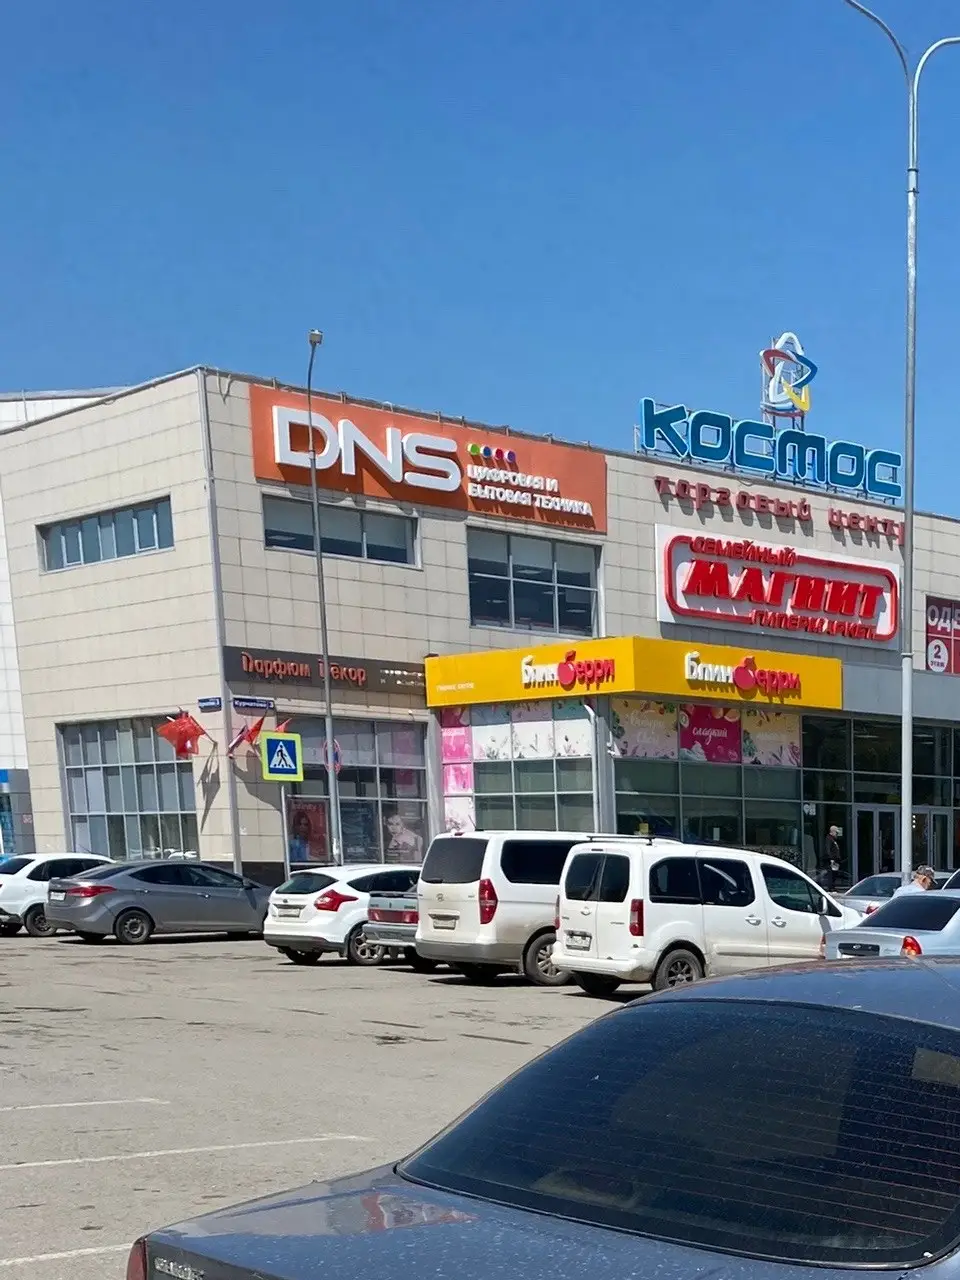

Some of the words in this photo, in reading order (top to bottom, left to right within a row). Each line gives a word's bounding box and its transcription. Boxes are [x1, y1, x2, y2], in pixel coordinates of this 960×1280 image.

[271, 404, 462, 492] DNS
[467, 463, 544, 491] ЦИФРОВАЯ
[545, 476, 558, 493] И
[467, 482, 532, 506] БЫТОВАЯ
[533, 493, 593, 516] ТЕХНИКА
[690, 535, 796, 567] СЕМЕЙНЫЙ
[682, 558, 884, 620] МАГНИТ
[750, 608, 877, 640] ГИПЕРМАРКЕТ
[240, 651, 311, 679] Парфюм
[933, 645, 941, 659] 2
